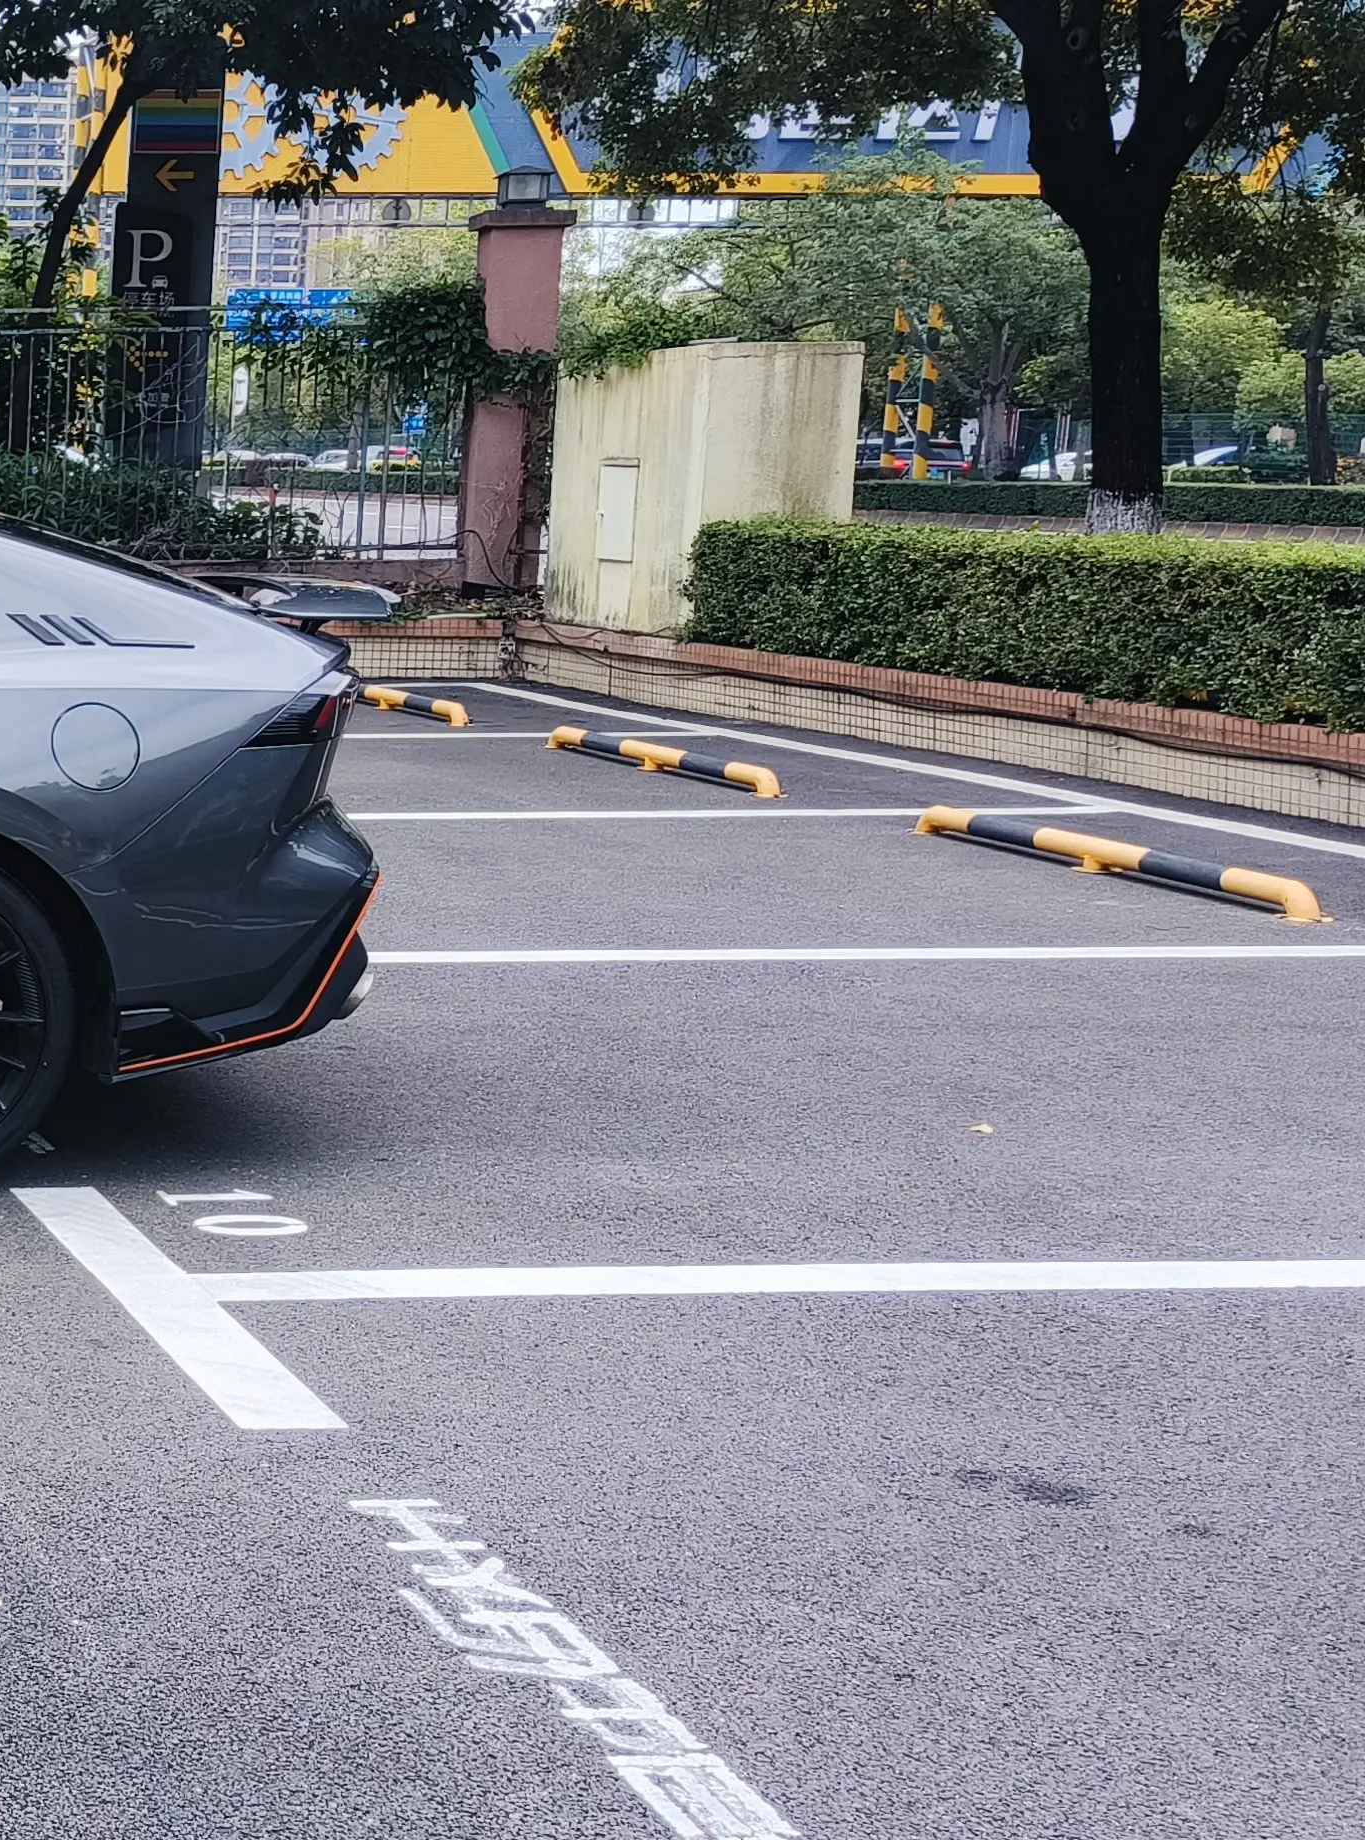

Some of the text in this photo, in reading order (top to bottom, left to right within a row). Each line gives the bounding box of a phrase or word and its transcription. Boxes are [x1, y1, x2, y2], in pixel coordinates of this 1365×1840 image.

[122, 229, 173, 287] P
[122, 290, 175, 309] 停车场
[155, 1188, 309, 1236] 10
